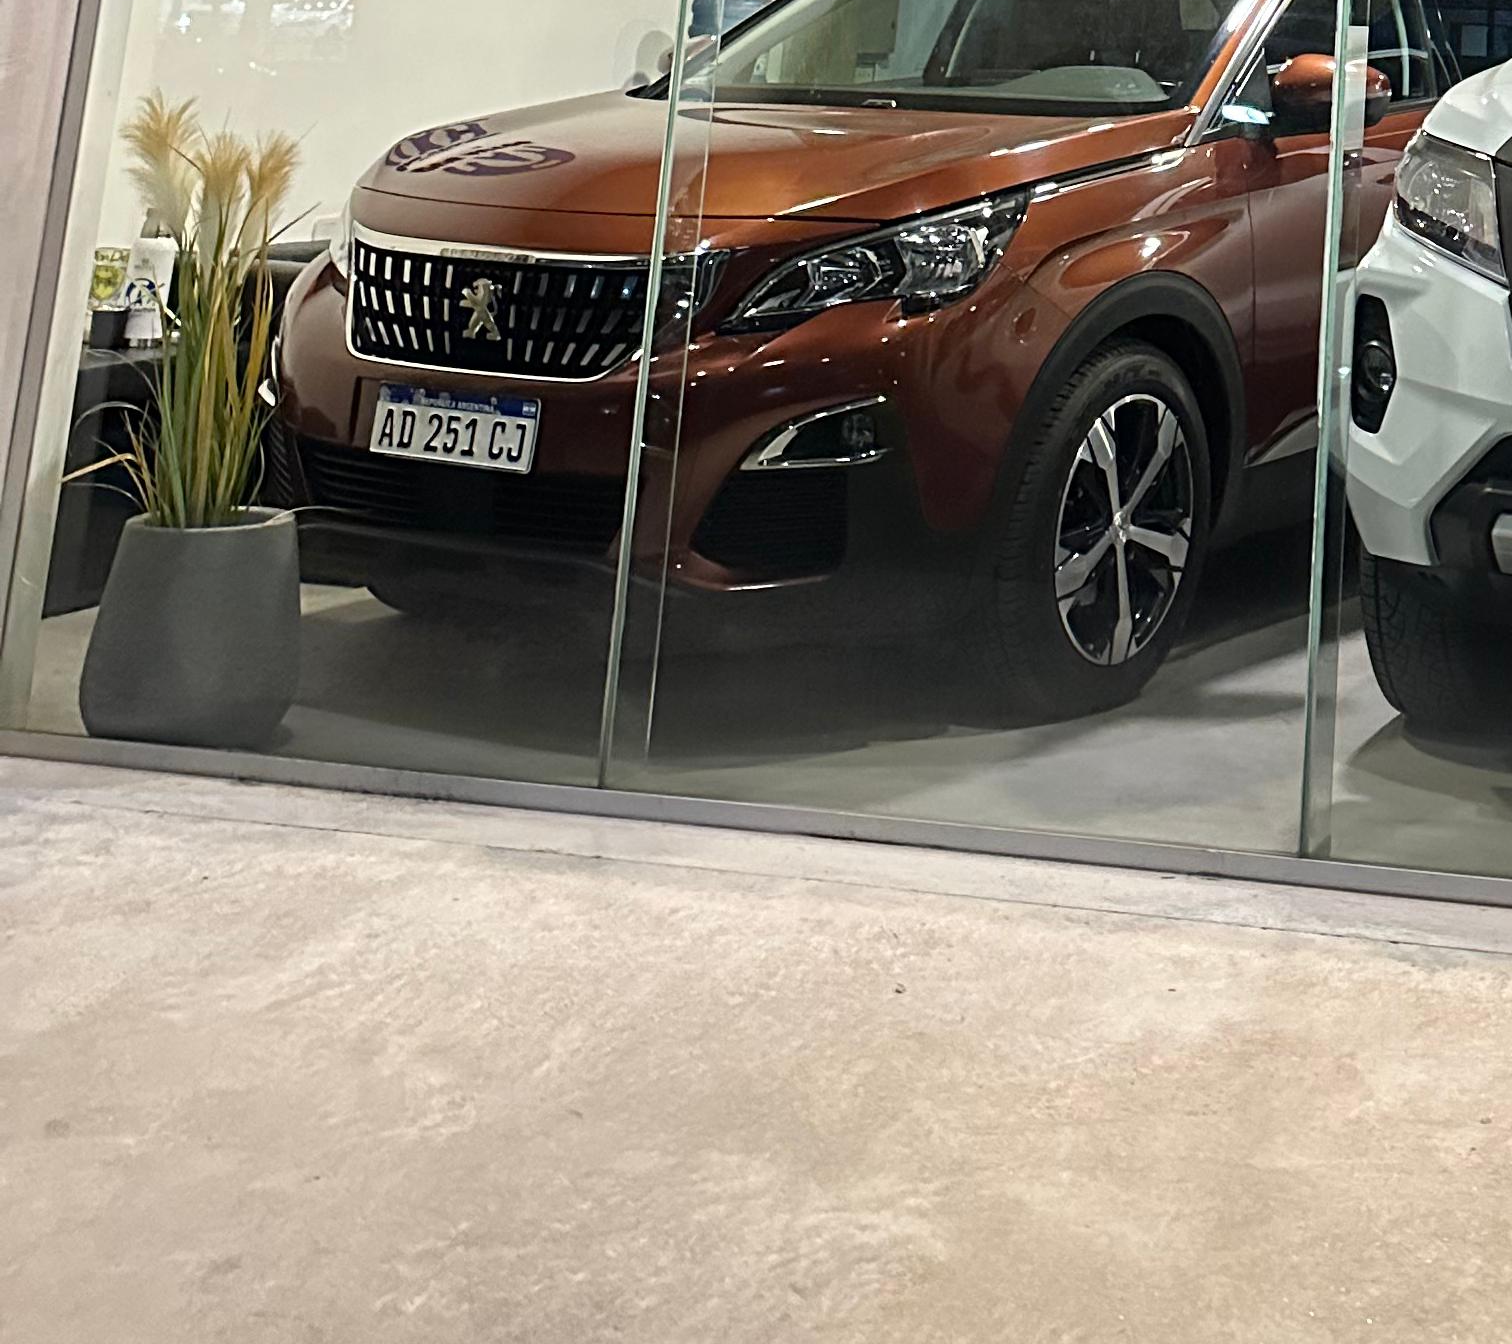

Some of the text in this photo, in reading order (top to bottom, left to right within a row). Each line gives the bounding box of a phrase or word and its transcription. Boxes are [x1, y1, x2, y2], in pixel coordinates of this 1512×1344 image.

[378, 407, 527, 463] AD 251 CJ
